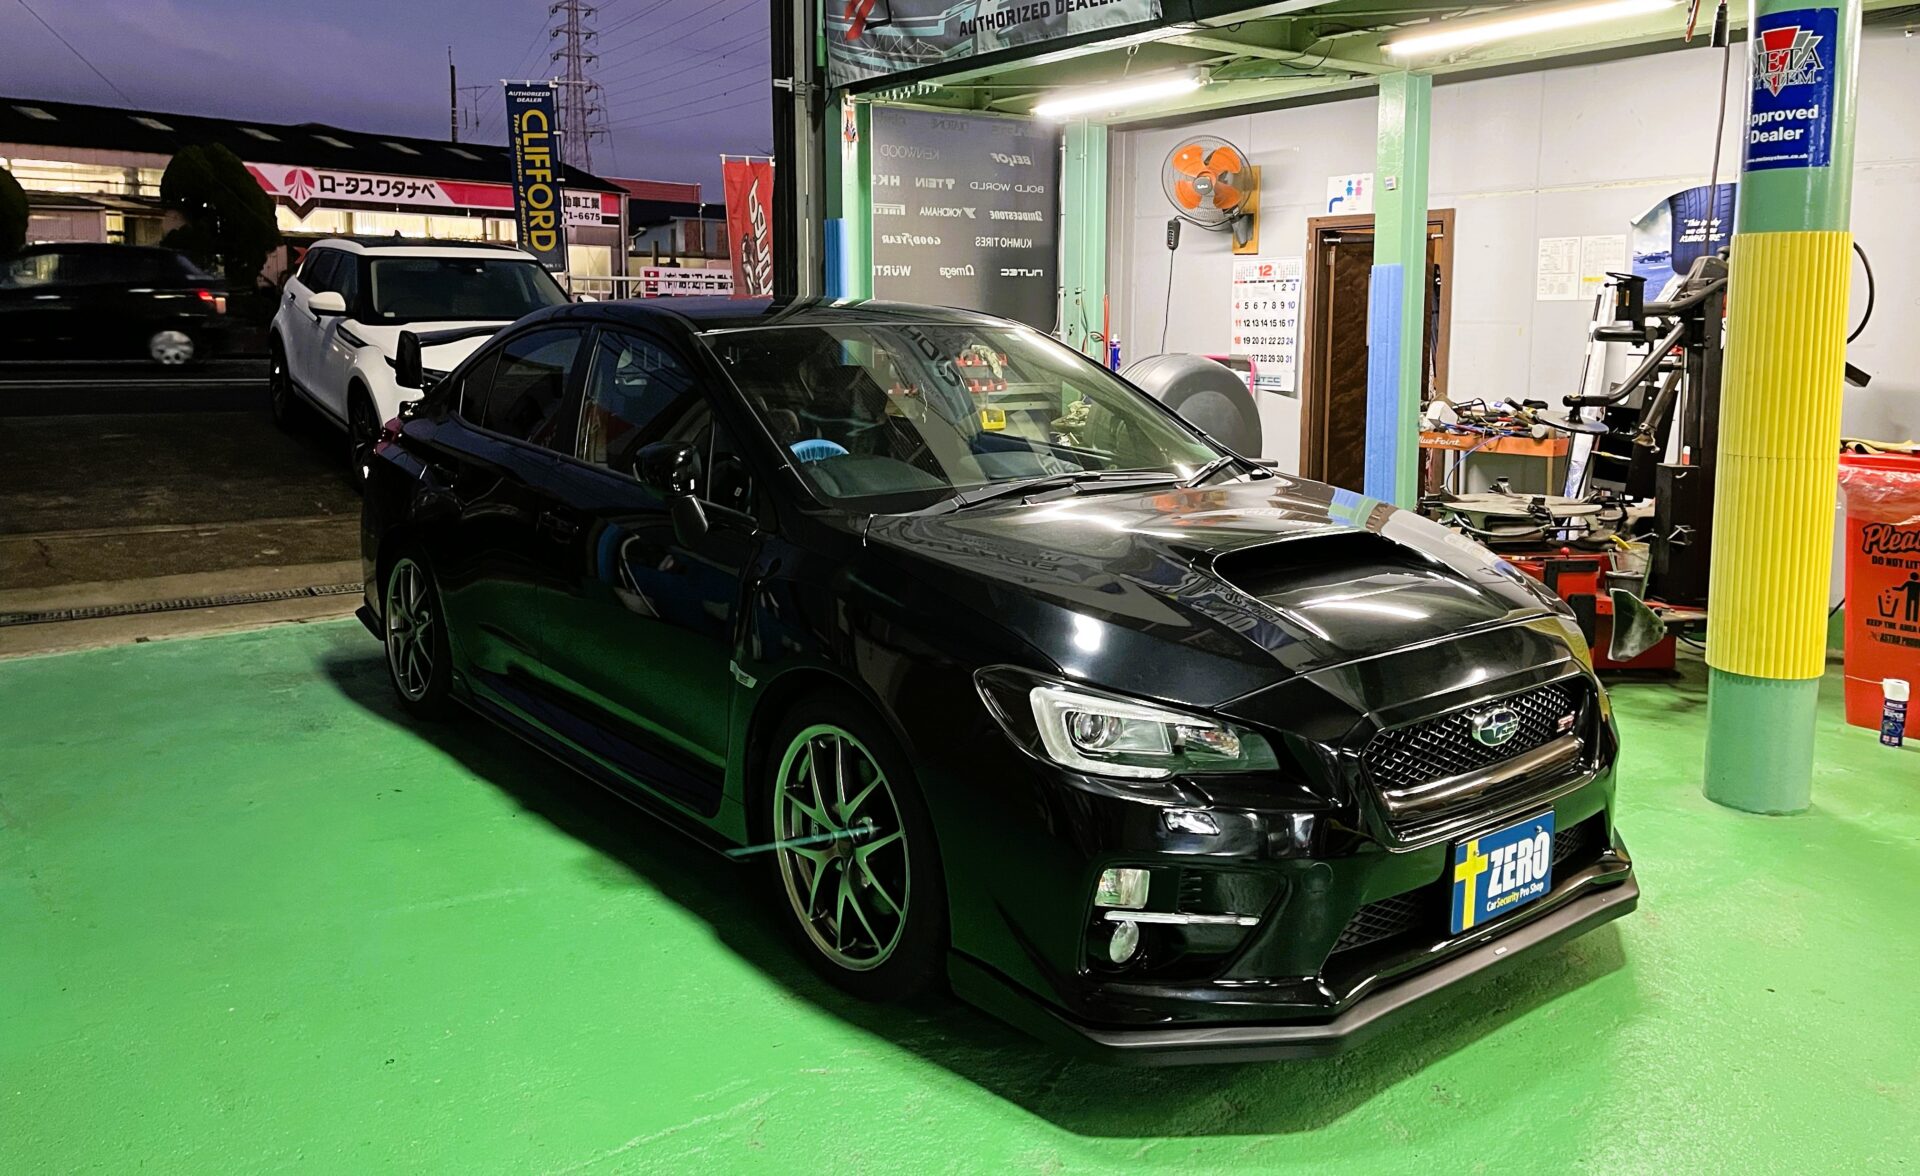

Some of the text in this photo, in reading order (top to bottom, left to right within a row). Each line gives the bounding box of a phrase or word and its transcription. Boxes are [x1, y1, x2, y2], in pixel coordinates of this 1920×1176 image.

[959, 1, 1050, 37] AUTHORIZED
[508, 90, 550, 98] AUTHORIZED
[1751, 104, 1819, 127] pproved
[1750, 127, 1804, 144] Dealer
[515, 137, 524, 183] Science
[319, 174, 436, 199] ロータスワタナベ
[522, 109, 558, 252] CLIFFORD
[519, 185, 526, 198] of
[520, 200, 529, 247] Security
[1258, 265, 1273, 277] 12
[1291, 283, 1296, 291] 3
[1287, 301, 1295, 309] 10
[1243, 319, 1250, 327] 12
[1252, 319, 1259, 327] 13
[1261, 319, 1268, 327] 14
[1270, 319, 1277, 327] 15
[1279, 319, 1286, 327] 16
[1287, 319, 1294, 327] 17
[1285, 337, 1293, 345] 24
[1252, 354, 1292, 363] 27 28 29 30 31
[1419, 436, 1460, 445] lue-Point
[1872, 555, 1884, 565] DO
[1886, 557, 1904, 568] NOT
[1488, 831, 1550, 898] ZERO
[1520, 887, 1530, 898] Pro
[1530, 881, 1544, 893] Shop
